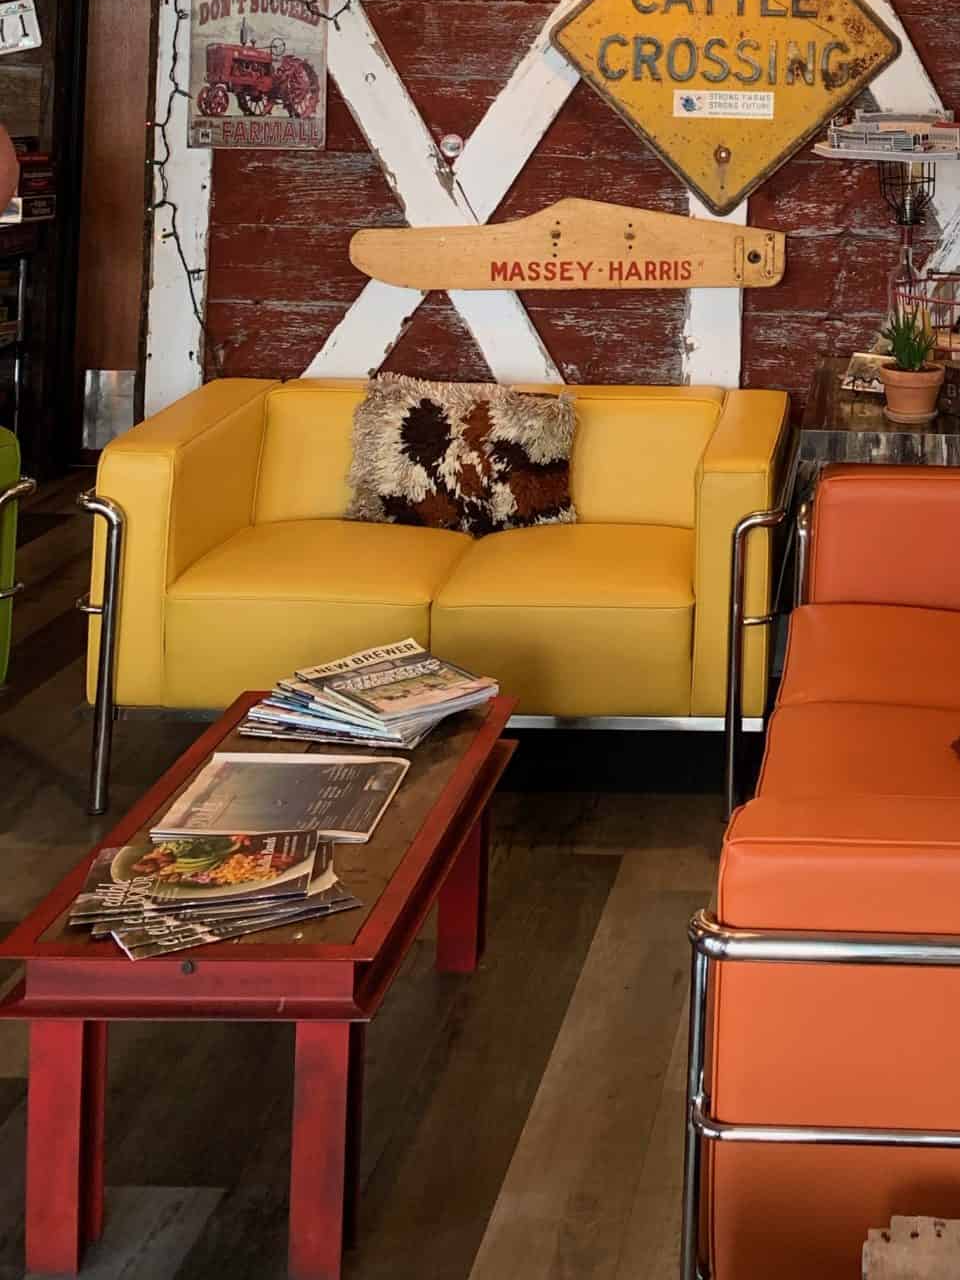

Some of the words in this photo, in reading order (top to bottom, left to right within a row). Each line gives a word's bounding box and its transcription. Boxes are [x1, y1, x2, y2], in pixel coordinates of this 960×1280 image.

[596, 33, 852, 91] CROSSING
[222, 121, 320, 144] FARMALL
[490, 260, 591, 282] MASSEY
[608, 260, 693, 281] HARRIS
[315, 659, 350, 676] NEW
[351, 642, 419, 666] BREWER
